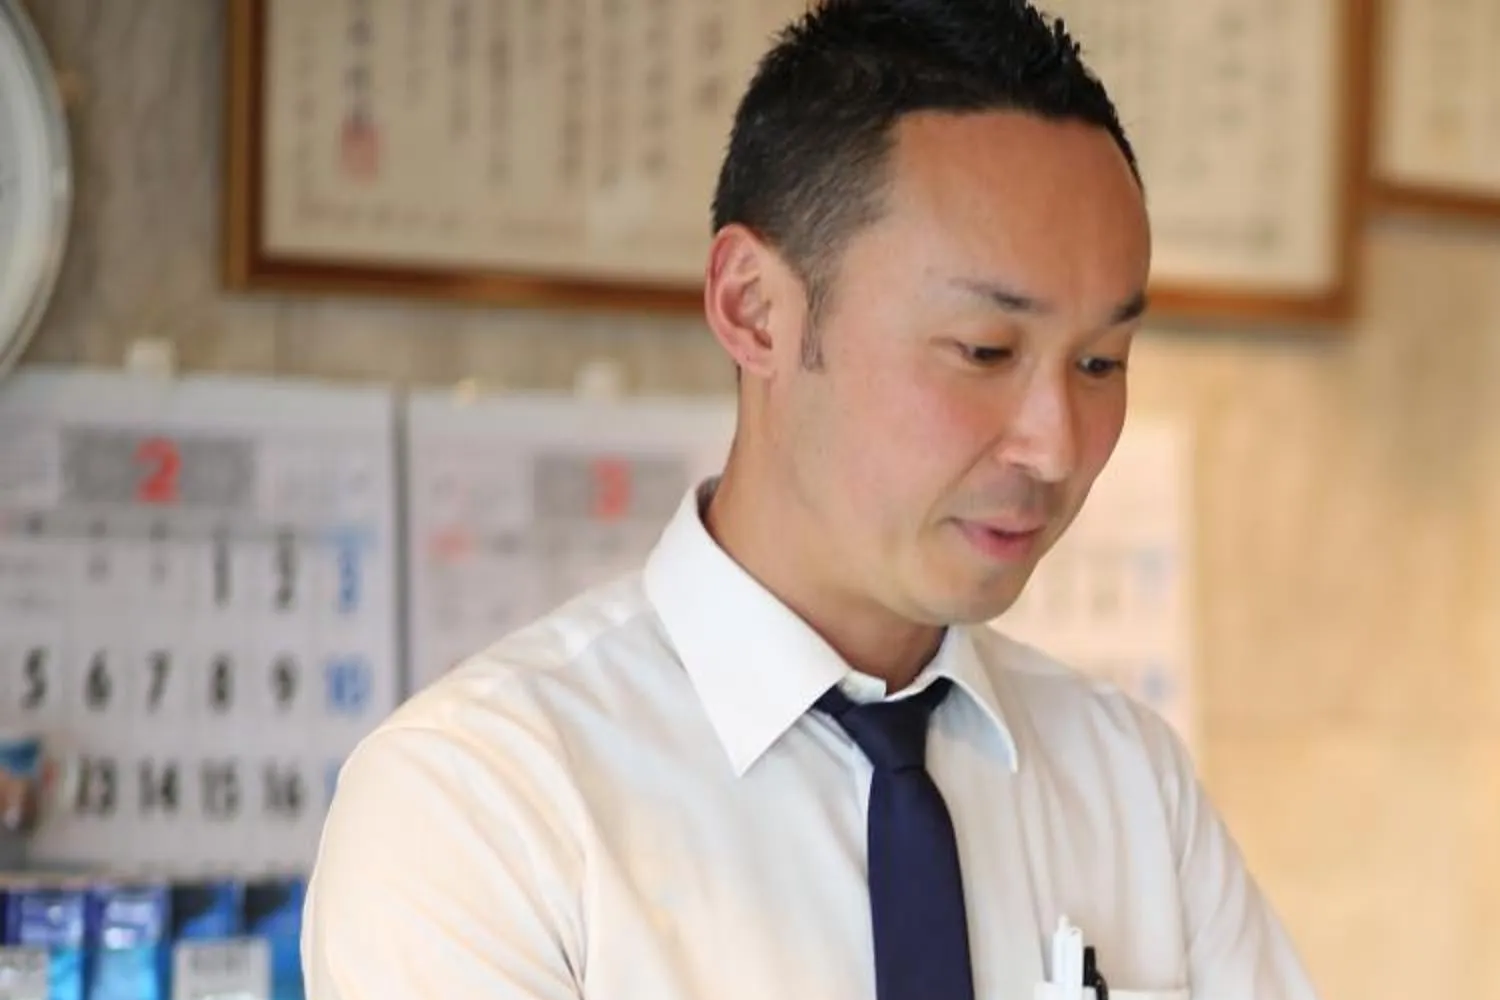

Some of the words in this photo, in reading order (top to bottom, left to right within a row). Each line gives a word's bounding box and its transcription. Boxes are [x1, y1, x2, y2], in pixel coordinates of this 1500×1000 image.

[132, 434, 182, 504] 2
[211, 540, 232, 605] 1
[21, 647, 47, 710] 5
[84, 650, 112, 712] 6
[147, 649, 172, 713] 7
[206, 653, 234, 714] 8
[269, 656, 297, 715] 9
[323, 658, 372, 718] 10
[138, 756, 181, 818] 14
[199, 757, 241, 820] 15
[261, 757, 307, 820] 16
